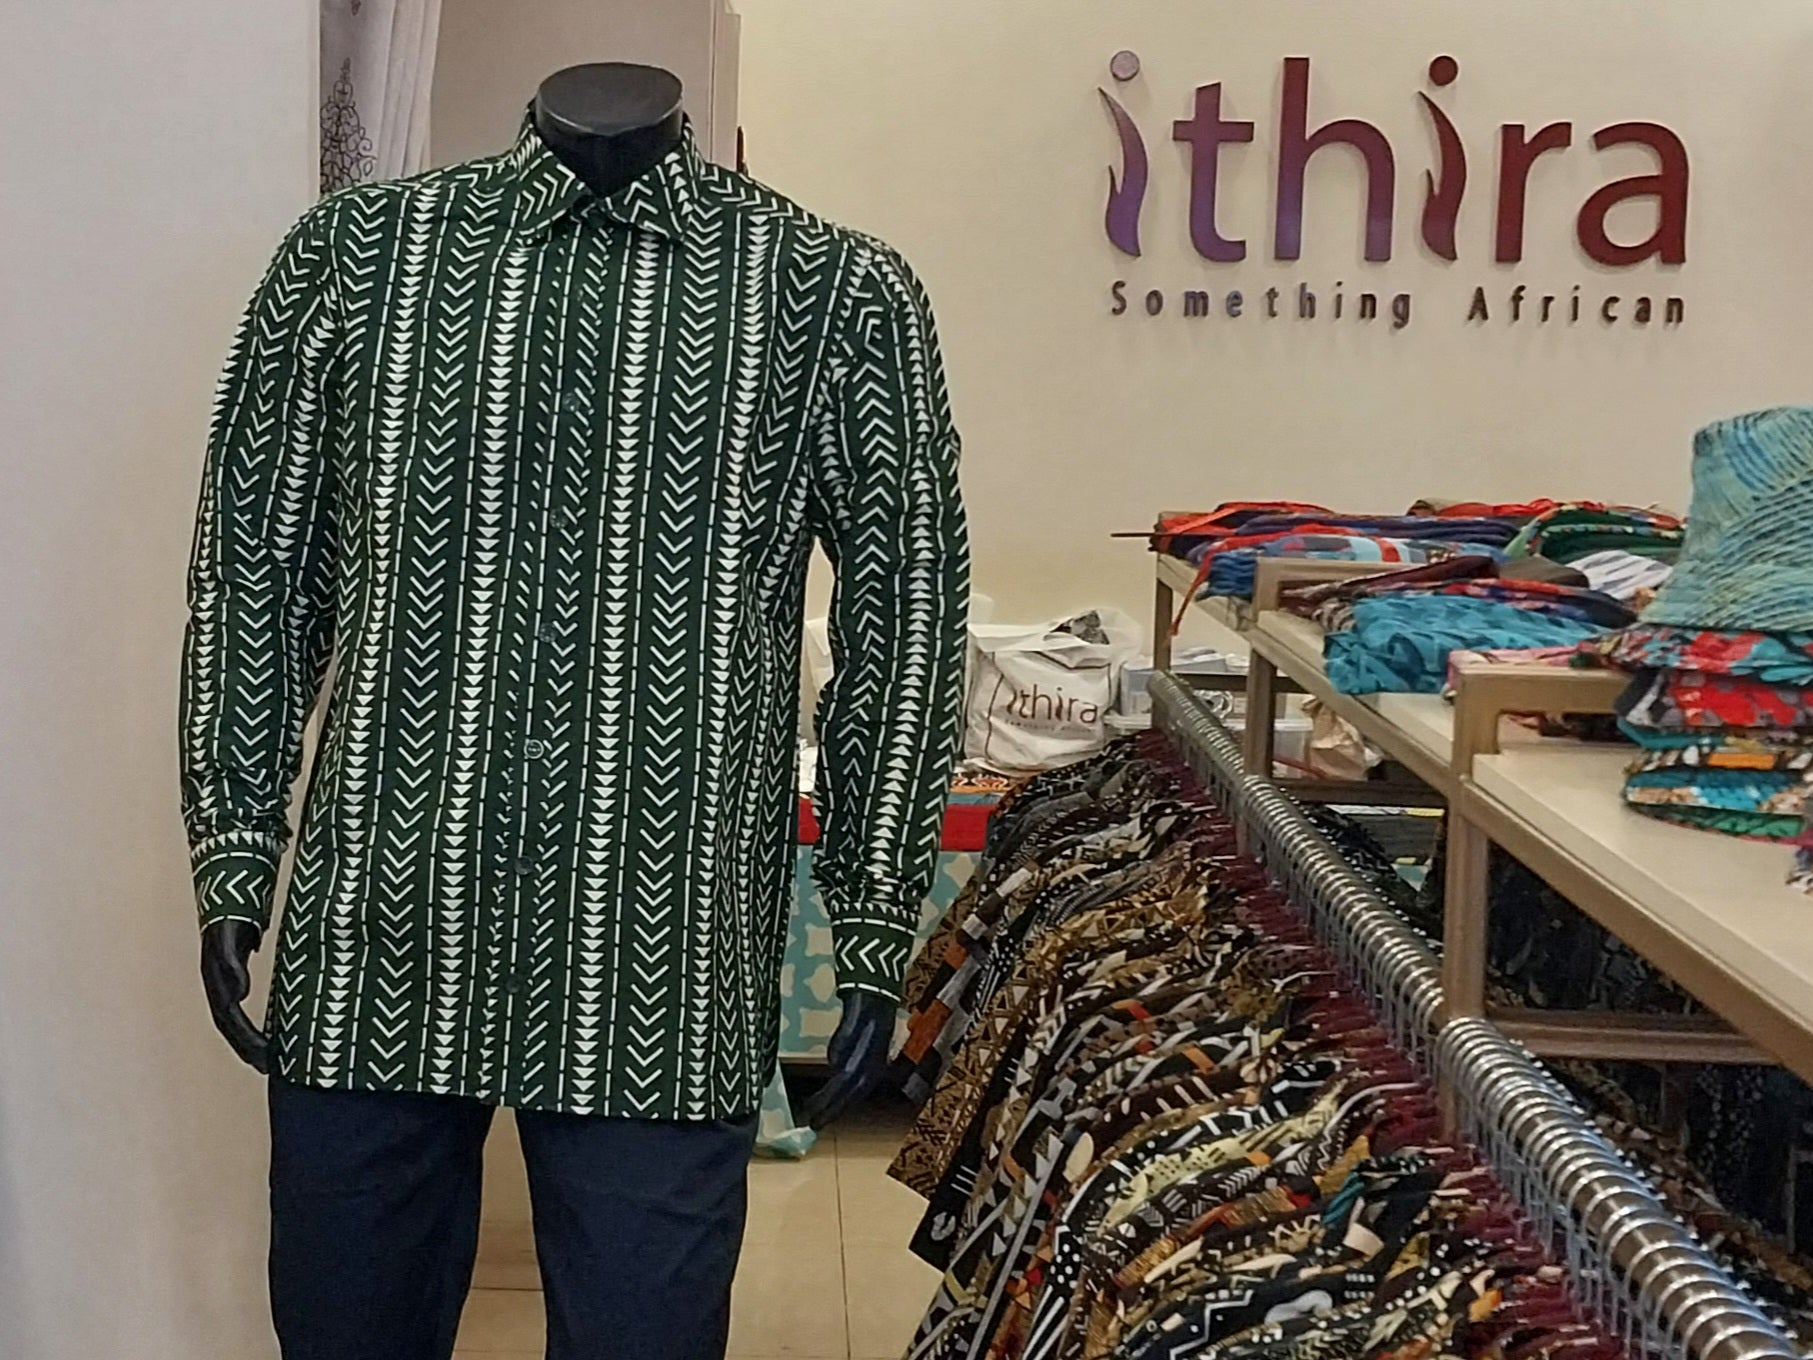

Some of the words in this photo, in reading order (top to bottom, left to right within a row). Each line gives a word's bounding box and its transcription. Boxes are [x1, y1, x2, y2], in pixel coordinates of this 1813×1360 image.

[1098, 49, 1690, 266] ithira
[1110, 279, 1412, 329] Something
[1466, 284, 1685, 324] African
